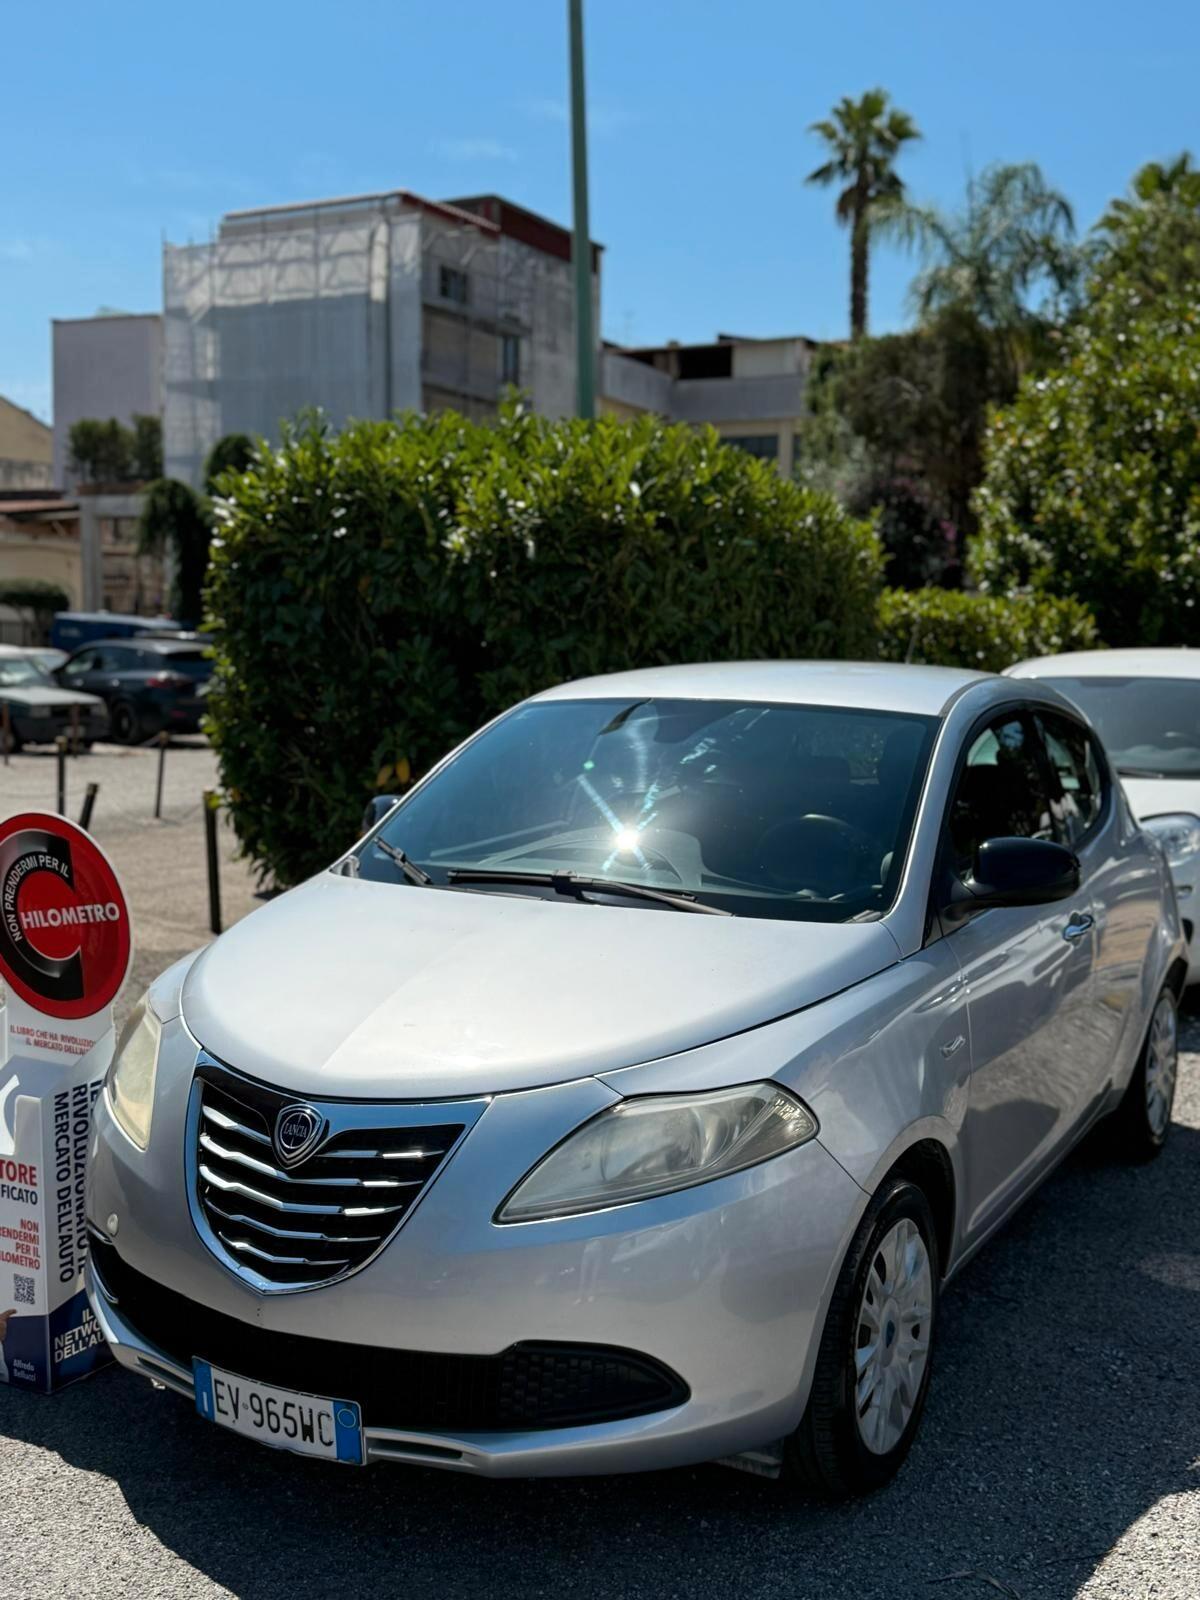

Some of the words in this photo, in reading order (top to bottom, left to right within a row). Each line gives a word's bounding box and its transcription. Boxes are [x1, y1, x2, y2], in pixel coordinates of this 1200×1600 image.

[38, 854, 59, 871] PER
[60, 862, 69, 878] IL
[5, 855, 38, 911] PRENDERMI
[7, 914, 22, 941] NON
[17, 1026, 35, 1037] LIBRO
[36, 1029, 48, 1039] CHE
[33, 1038, 63, 1052] MERCATO
[54, 1091, 71, 1183] MERCATO
[1, 1184, 38, 1206] FICATO
[20, 1218, 39, 1233] NON
[57, 1185, 75, 1283] DELL'AUTO
[15, 1242, 31, 1255] PER
[32, 1246, 41, 1258] IL
[82, 1308, 94, 1323] IL
